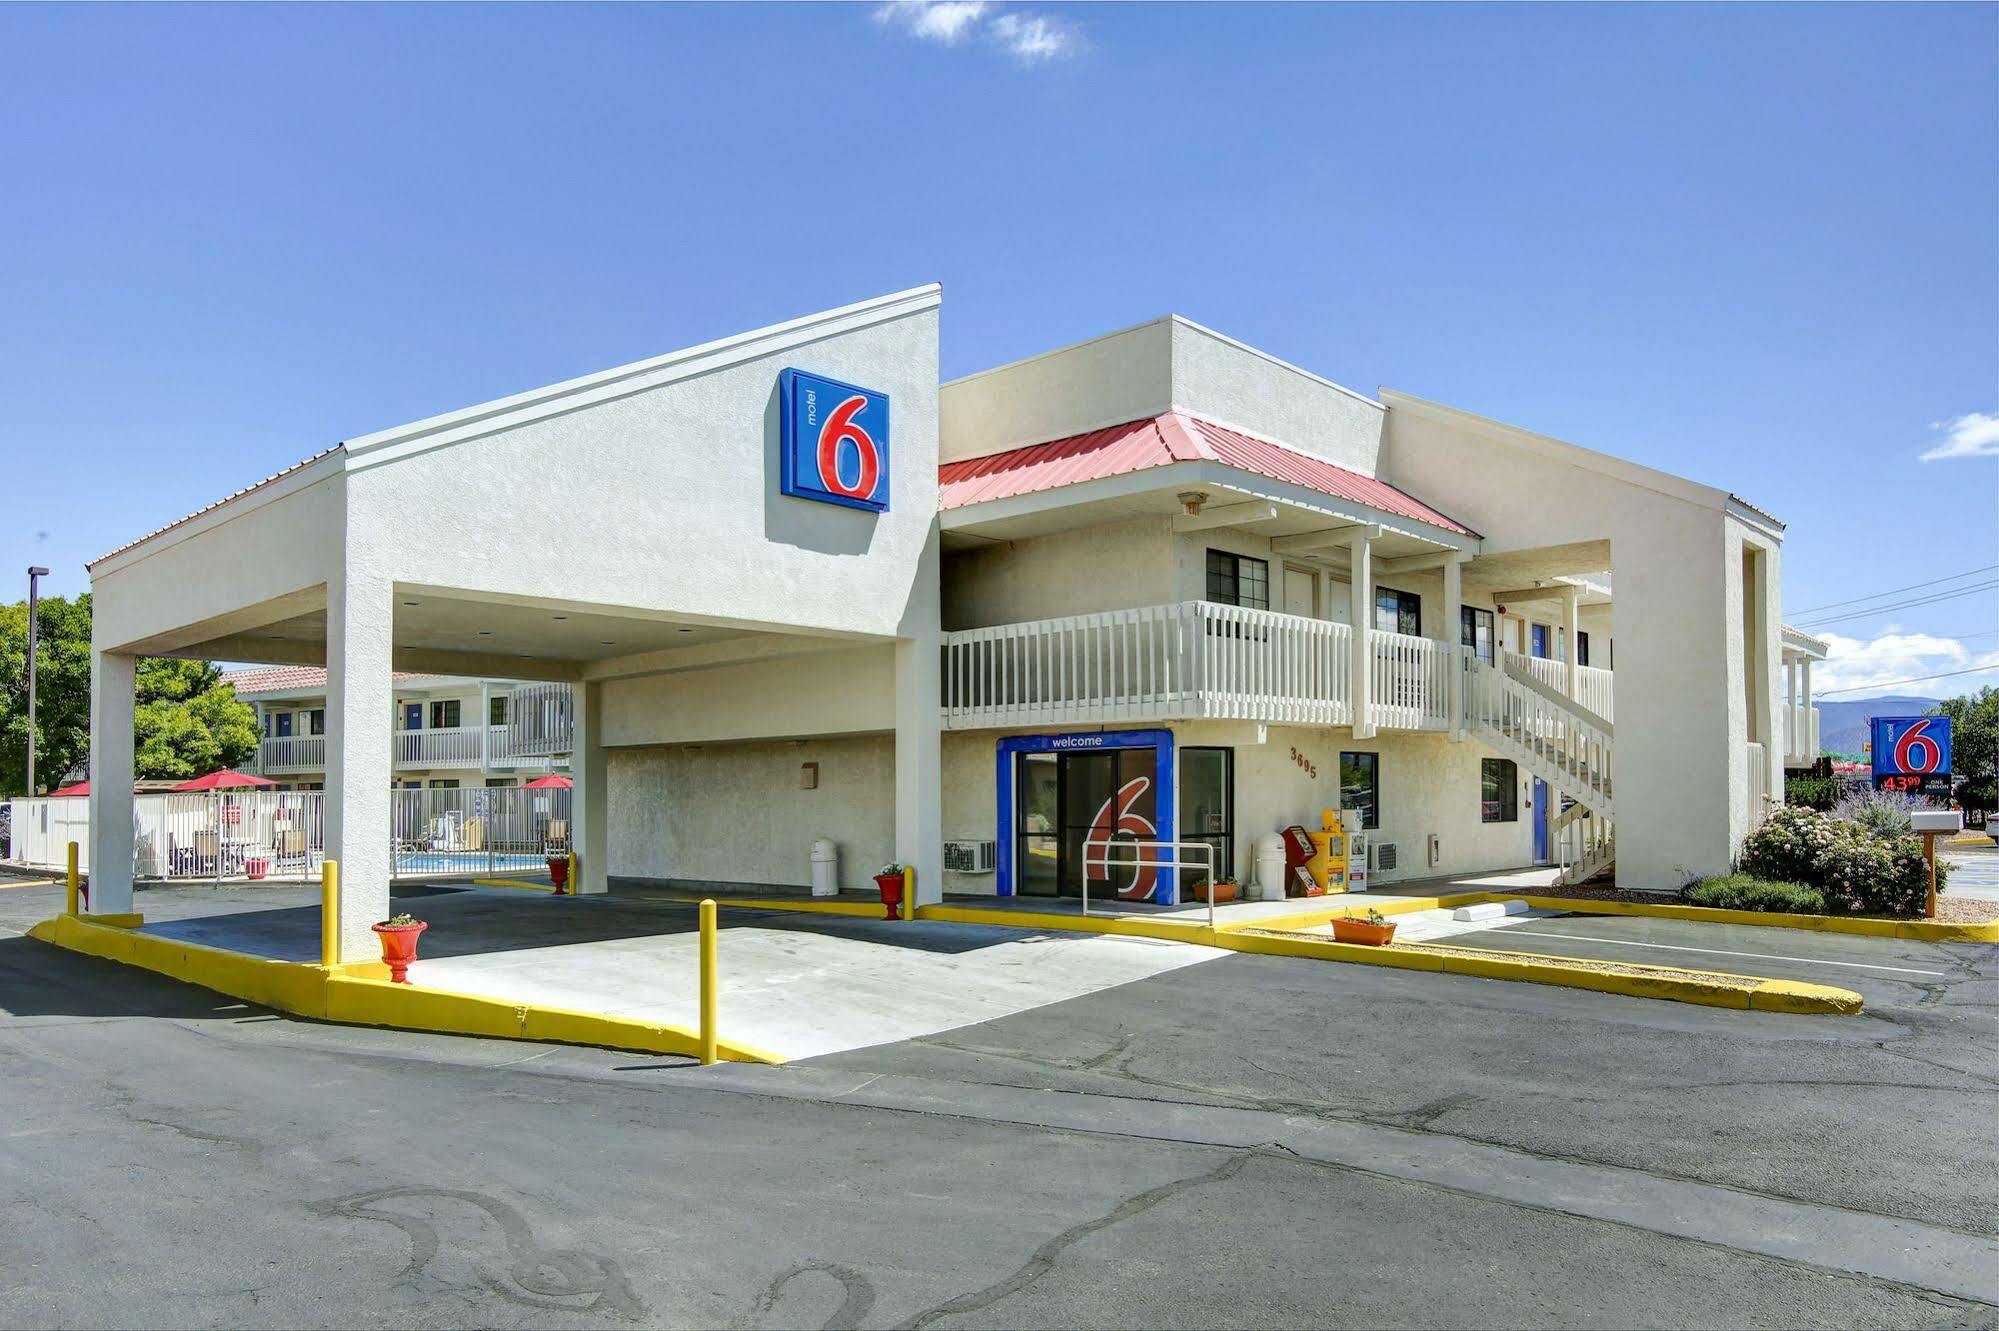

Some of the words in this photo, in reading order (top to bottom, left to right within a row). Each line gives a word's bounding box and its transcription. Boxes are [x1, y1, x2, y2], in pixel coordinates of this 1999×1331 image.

[805, 389, 817, 426] motel
[817, 395, 880, 500] 6
[1052, 736, 1103, 748] welcome
[1290, 746, 1317, 779] 3695
[1887, 723, 1895, 742] motel
[1894, 719, 1940, 774] 6
[1086, 776, 1158, 900] 6
